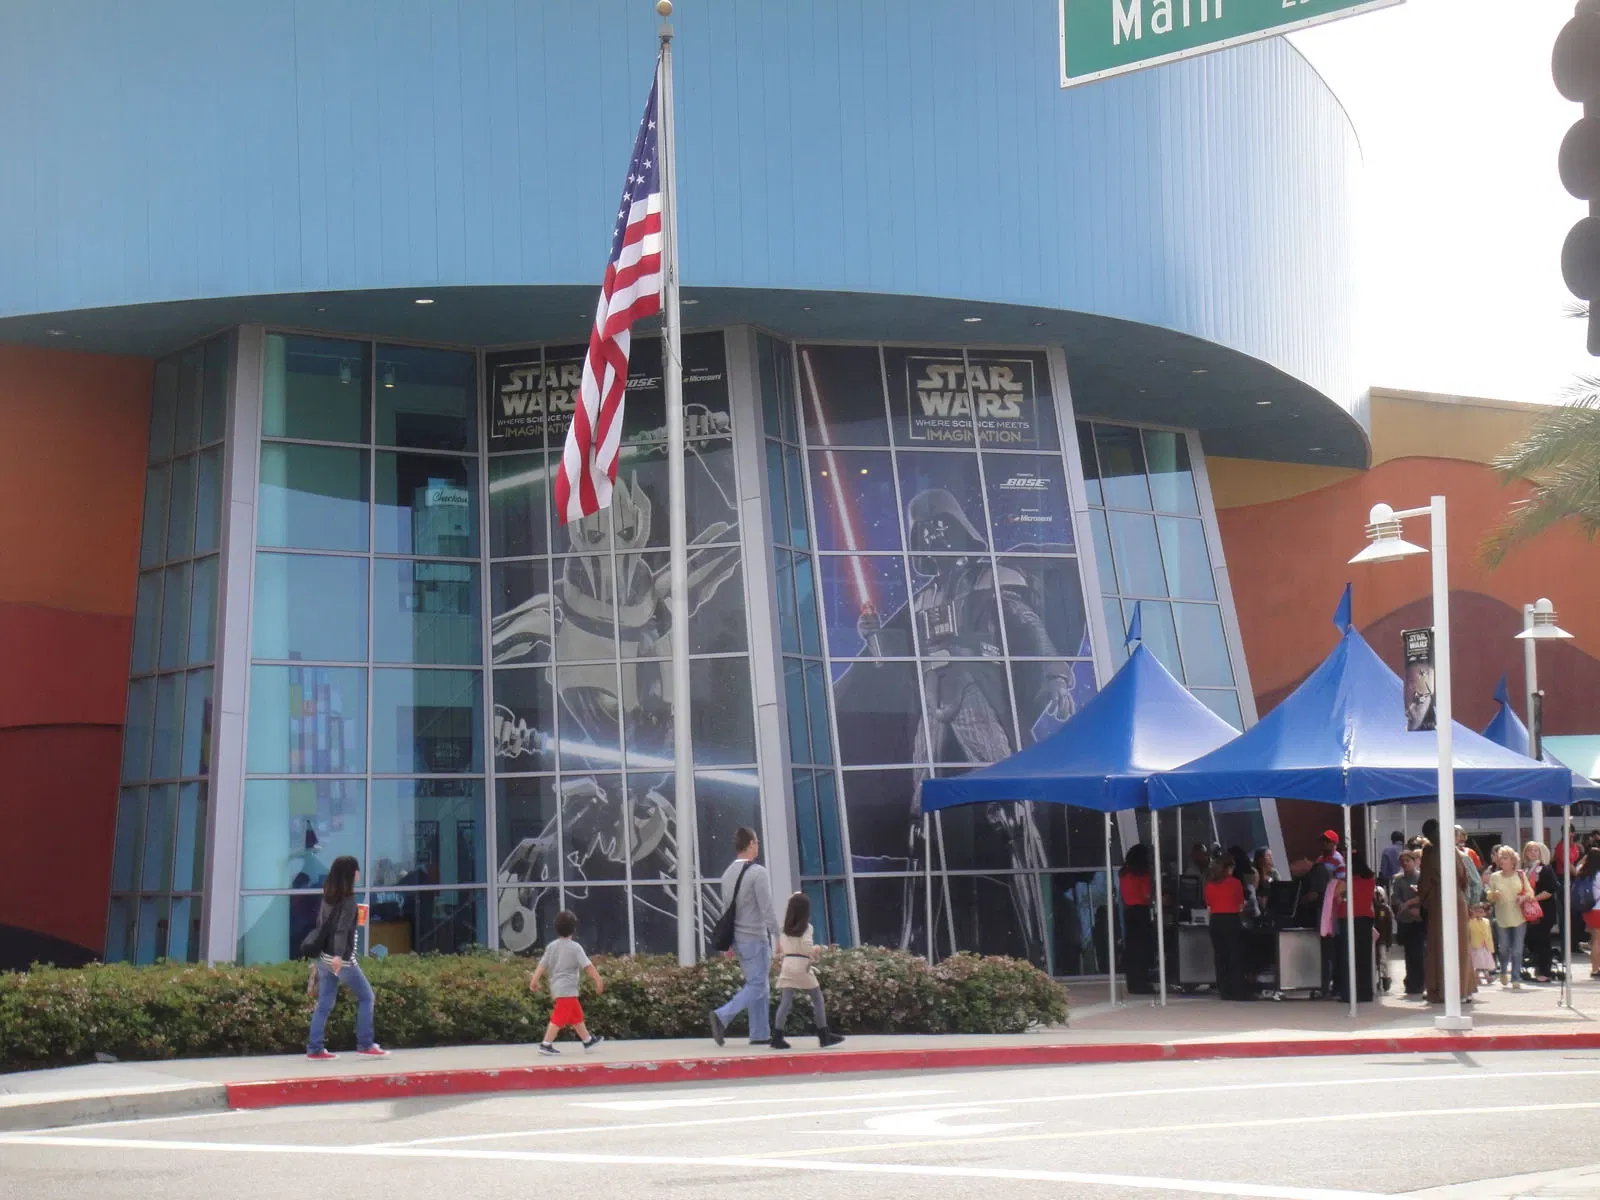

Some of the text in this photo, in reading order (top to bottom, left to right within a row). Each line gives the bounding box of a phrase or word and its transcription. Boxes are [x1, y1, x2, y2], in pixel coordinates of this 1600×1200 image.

[916, 364, 1024, 391] STAR
[916, 390, 1024, 419] WARS
[496, 417, 526, 427] WHERE
[915, 419, 951, 428] WHERE
[996, 421, 1030, 429] MEETS
[926, 429, 1022, 443] IMAGINATION
[1002, 478, 1050, 487] BOSE
